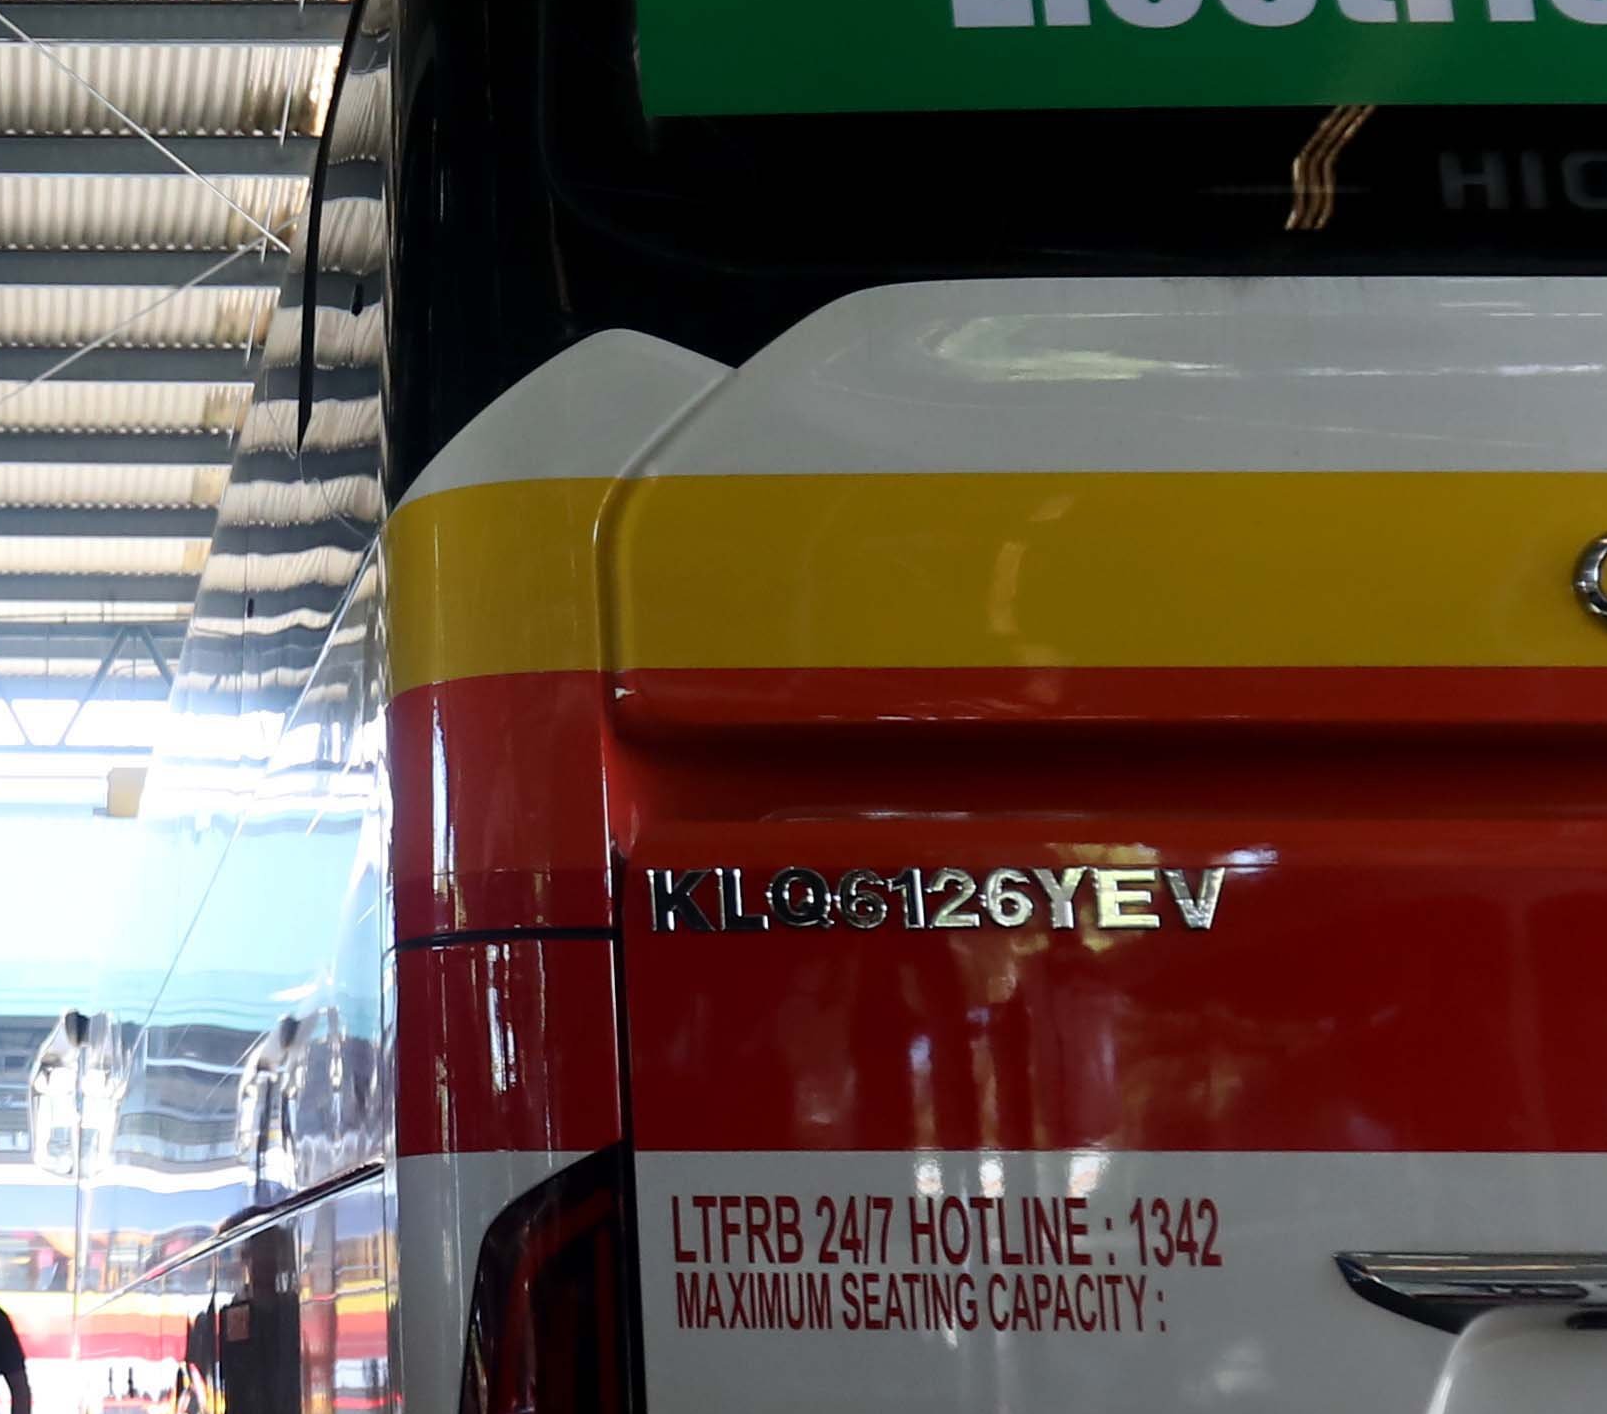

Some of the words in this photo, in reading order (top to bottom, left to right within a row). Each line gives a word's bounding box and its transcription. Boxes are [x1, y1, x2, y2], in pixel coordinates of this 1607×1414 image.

[646, 866, 1227, 932] KLQ6126YEV
[671, 1196, 804, 1265] LTFRB
[815, 1195, 894, 1265] 24/7
[910, 1196, 1088, 1266] HOTLINE
[1129, 1197, 1223, 1267] 1342
[676, 1272, 833, 1331] MAXIMUM
[842, 1273, 979, 1331] SEATING
[988, 1273, 1146, 1332] CAPACITY
